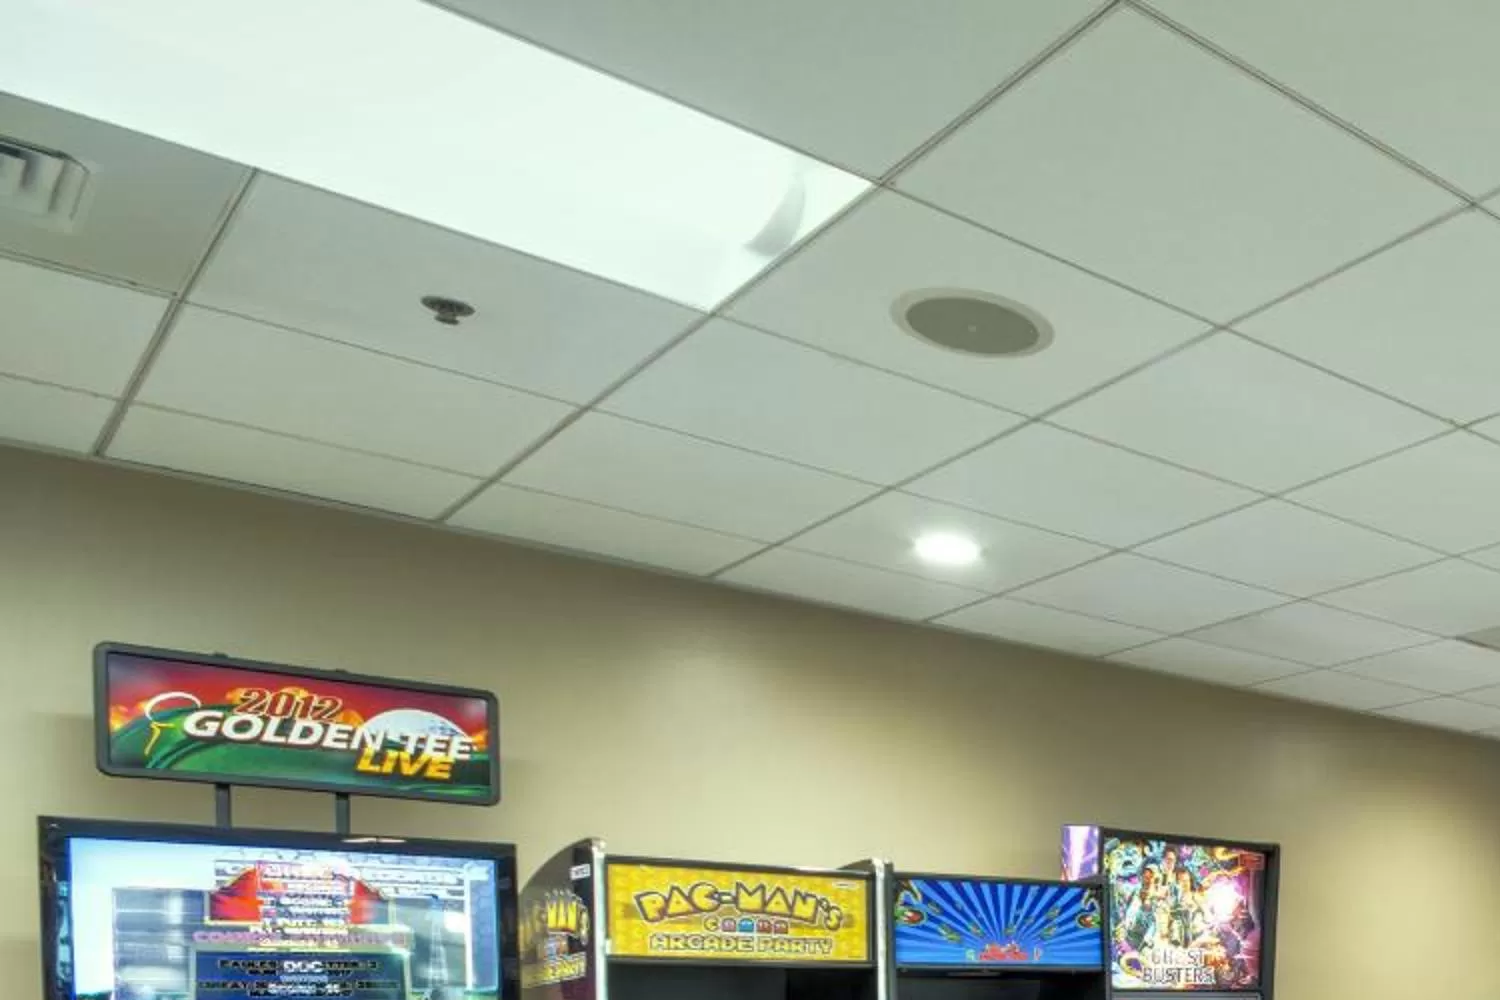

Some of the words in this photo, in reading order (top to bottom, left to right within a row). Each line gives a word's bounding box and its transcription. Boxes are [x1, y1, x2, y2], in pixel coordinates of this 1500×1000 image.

[232, 687, 344, 724] 2012
[183, 709, 383, 752] GOLDEN
[394, 733, 478, 760] TEE
[356, 746, 456, 780] LIVE
[649, 934, 753, 951] ARCADE
[756, 935, 834, 955] PARTY
[1143, 967, 1217, 985] BUSTERS
